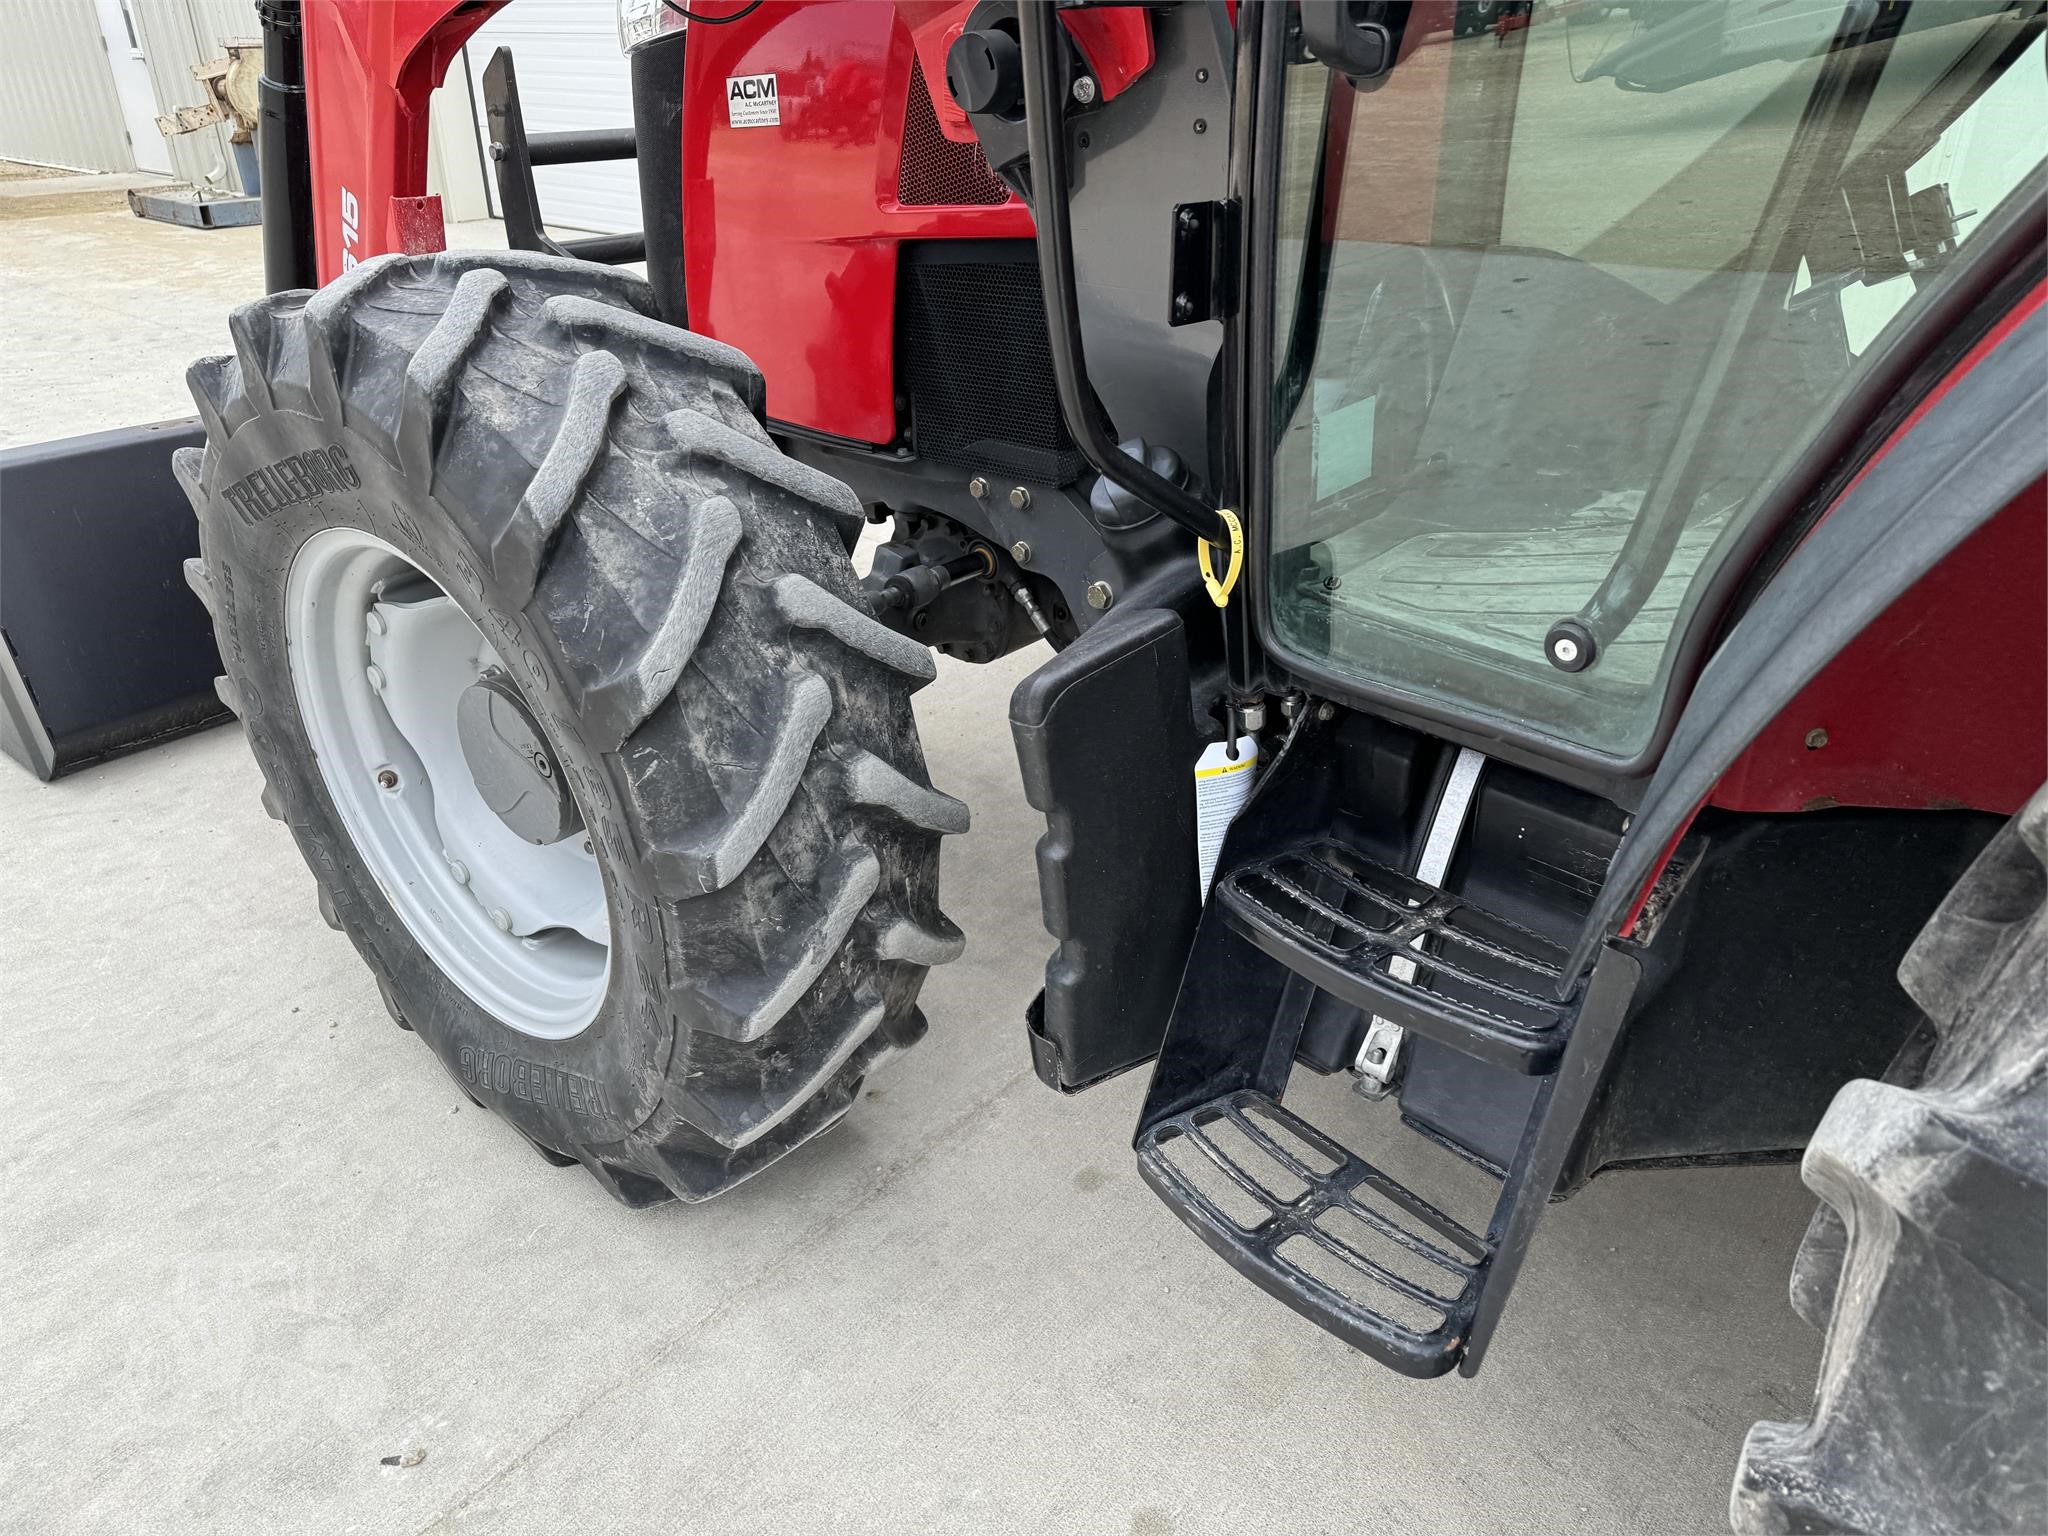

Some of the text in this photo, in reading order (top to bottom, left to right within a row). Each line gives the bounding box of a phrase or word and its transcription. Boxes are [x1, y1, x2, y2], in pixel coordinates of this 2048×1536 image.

[730, 78, 775, 100] ACM
[221, 443, 361, 527] TRELLEBORG
[459, 1046, 622, 1124] TRELLEBORG
